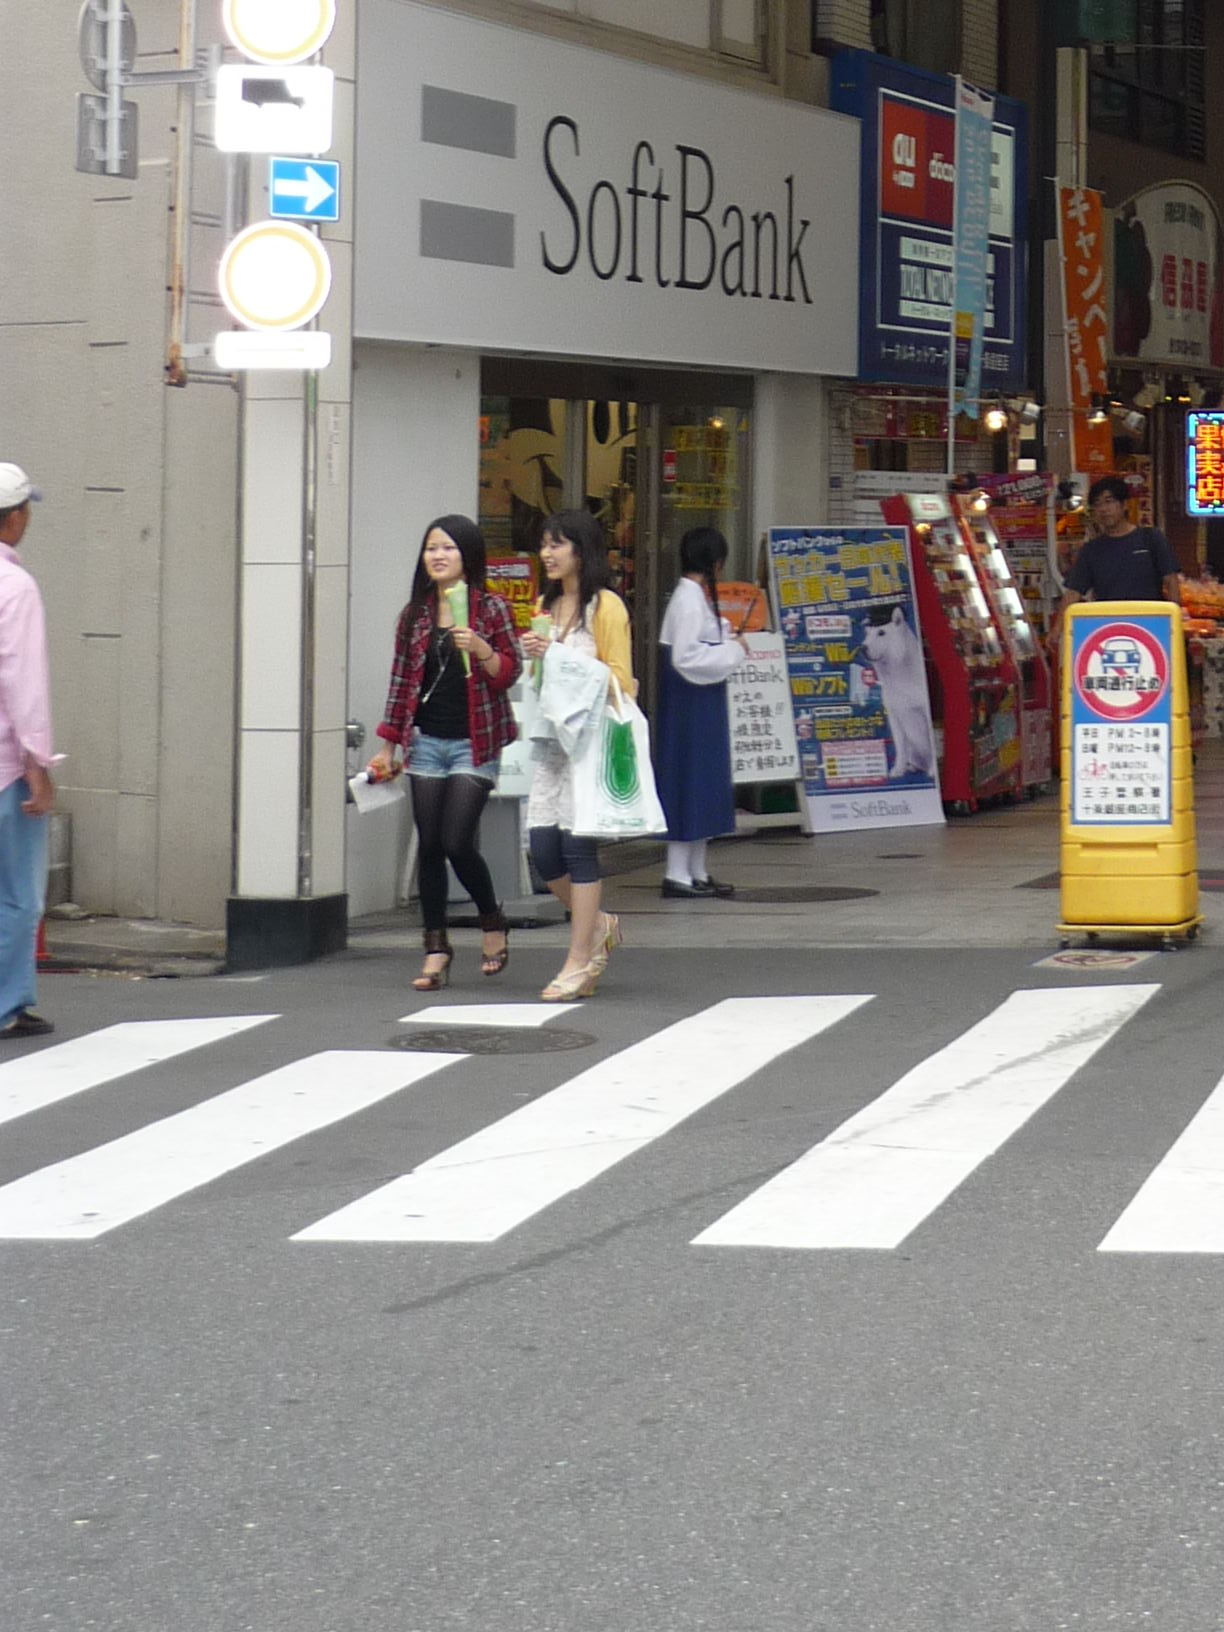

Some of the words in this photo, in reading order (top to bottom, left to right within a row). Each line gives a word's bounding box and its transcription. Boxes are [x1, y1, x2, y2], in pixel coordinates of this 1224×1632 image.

[893, 133, 916, 168] au
[541, 115, 813, 305] SoftBank
[1195, 424, 1222, 501] 果実店
[1083, 676, 1160, 690] 車両通行止め
[850, 799, 912, 819] SoftBank
